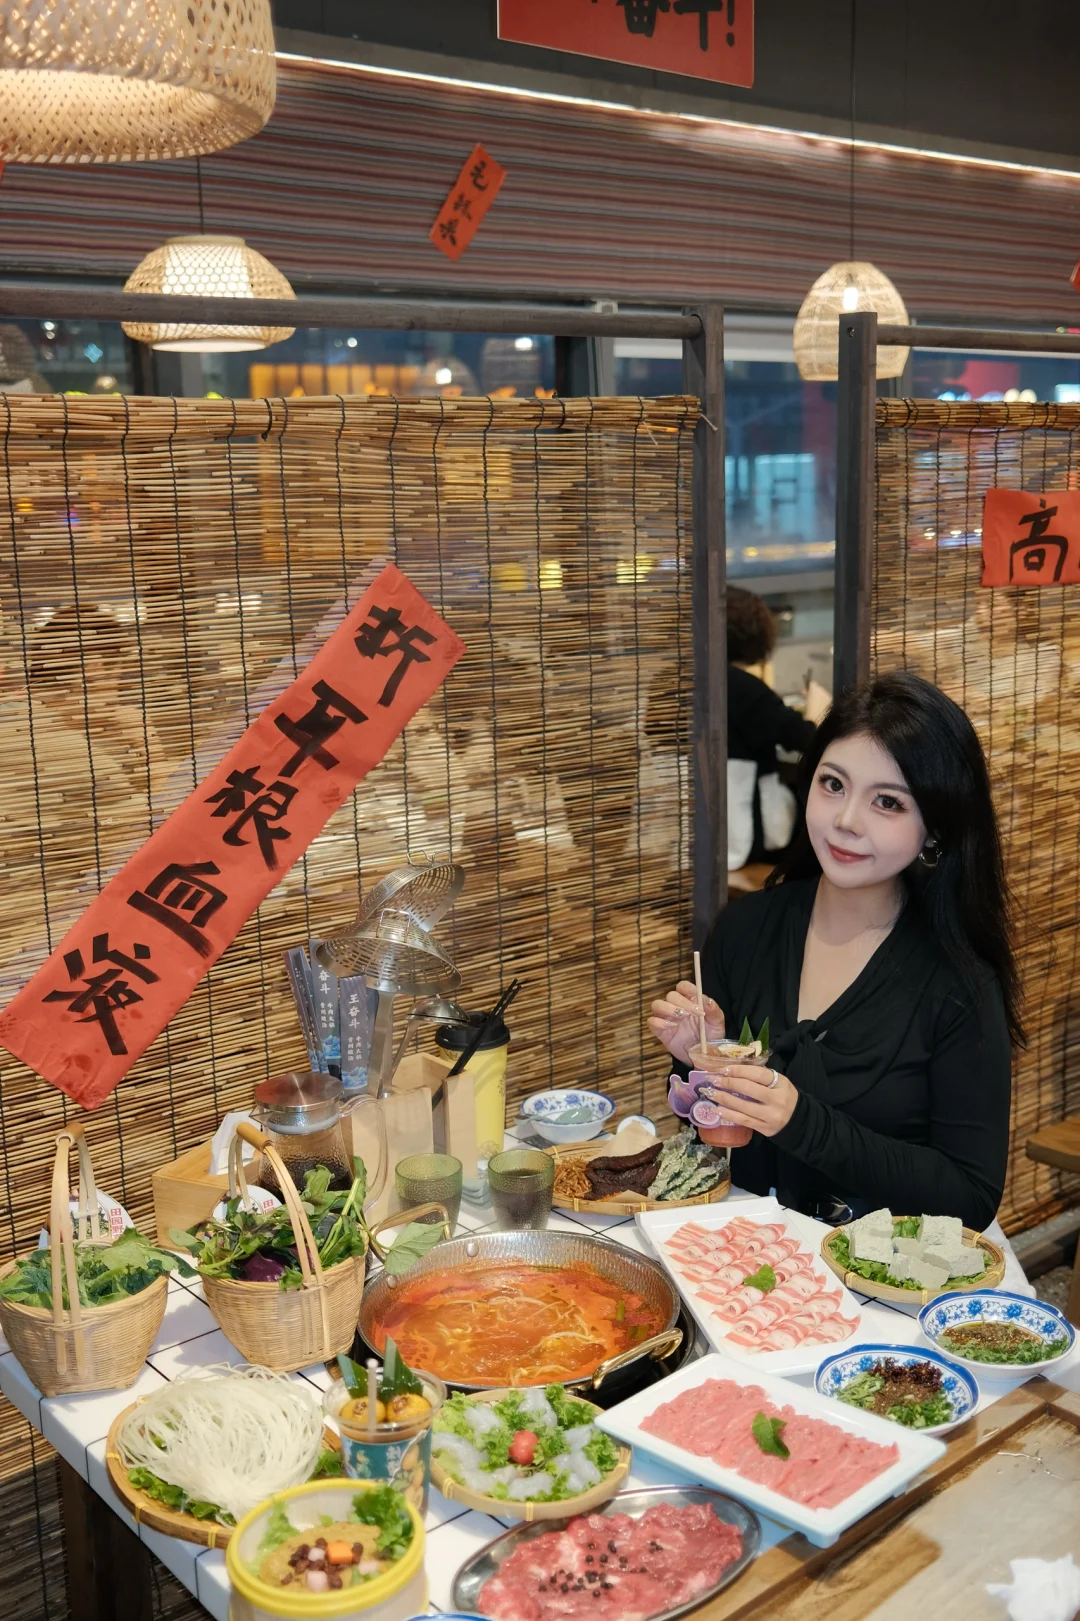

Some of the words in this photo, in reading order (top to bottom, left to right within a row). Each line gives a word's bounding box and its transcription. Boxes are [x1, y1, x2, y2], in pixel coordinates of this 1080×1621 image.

[1008, 499, 1069, 582] 高
[42, 604, 438, 1056] 折耳根血液
[318, 964, 331, 995] 奋斗
[348, 993, 361, 1029] 王奋斗
